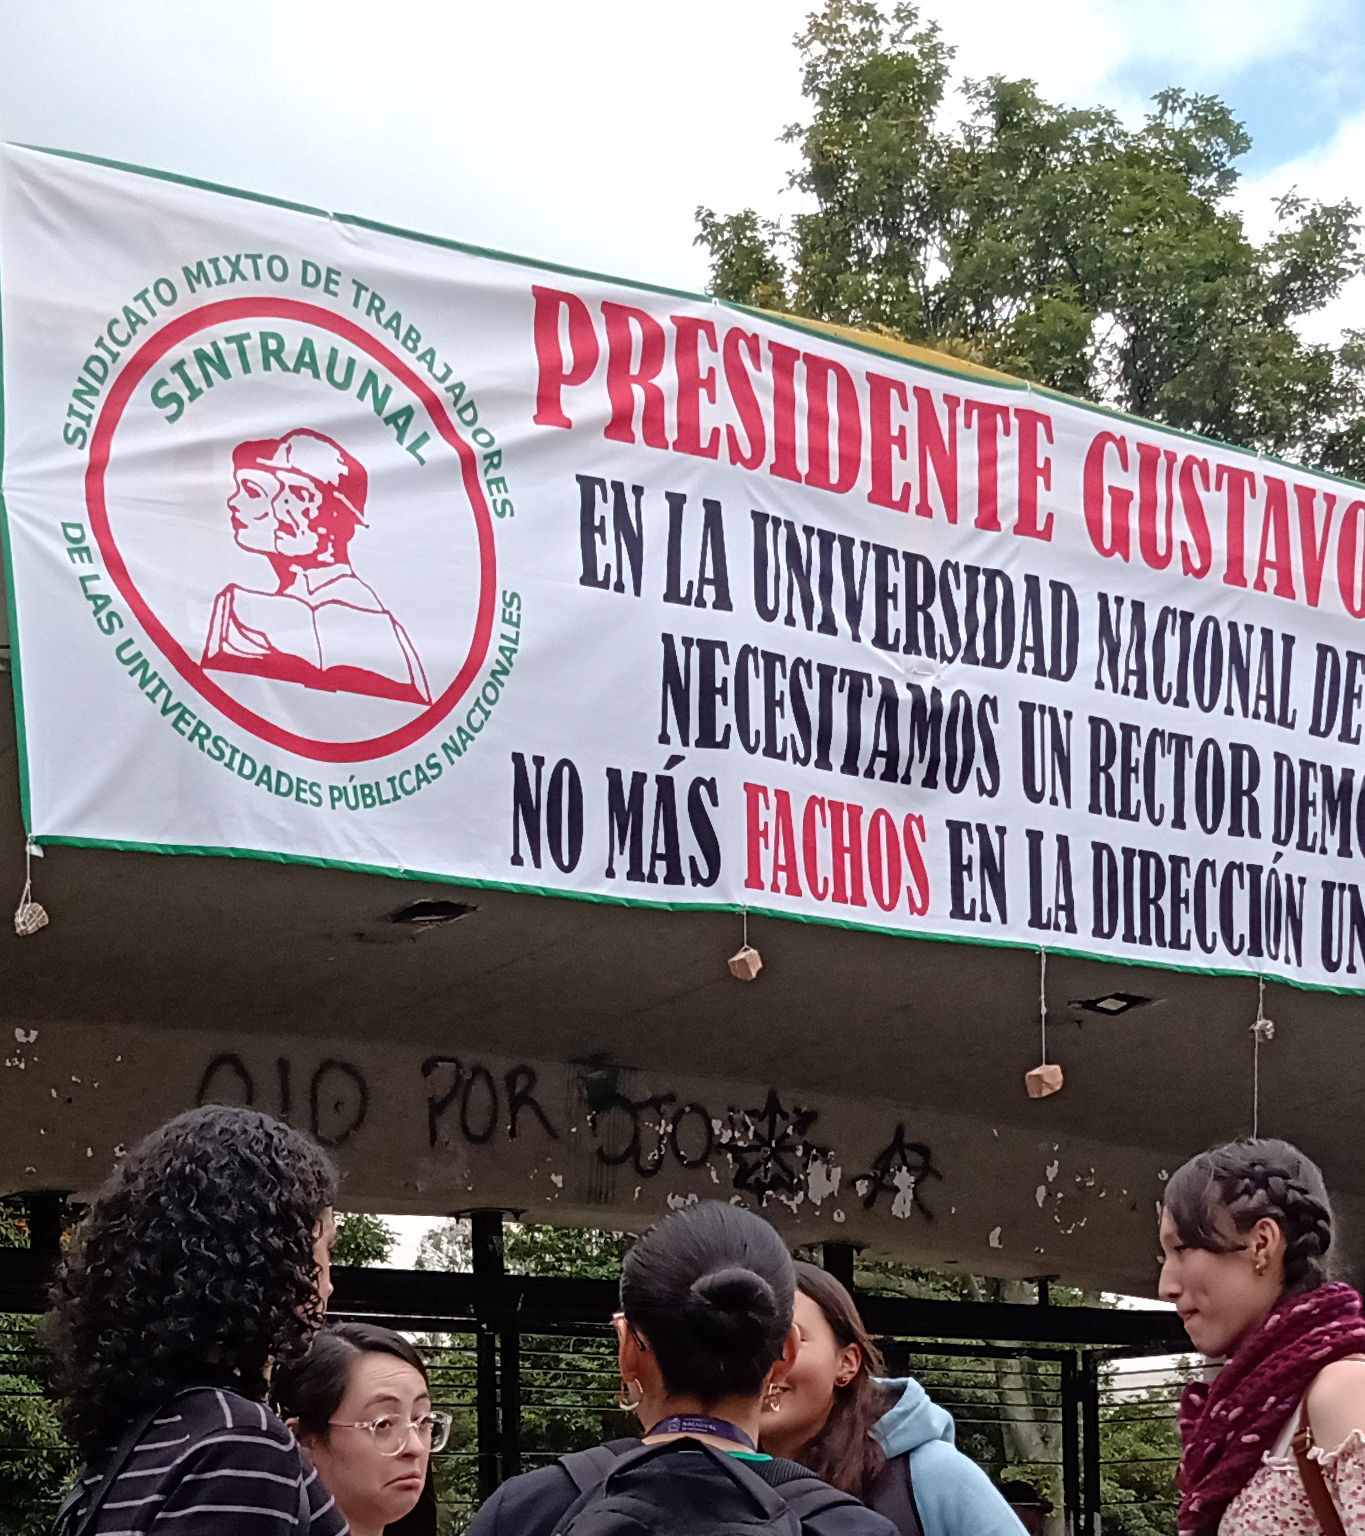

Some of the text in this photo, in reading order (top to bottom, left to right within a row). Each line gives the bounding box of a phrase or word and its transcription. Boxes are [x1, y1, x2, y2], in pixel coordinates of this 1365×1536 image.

[62, 253, 515, 520] SINDICATO MIXTO DE TRABAJADORES
[150, 331, 433, 466] SINTRAUNAL
[531, 284, 1054, 541] PRESIDENTE
[60, 520, 521, 811] DE LAS UNIVERSIDADES PÚBLICAS NACIONALES
[575, 473, 644, 598] EN
[663, 491, 732, 612] LA
[750, 510, 1078, 682] UNIVERSIDAD
[1093, 591, 1297, 731] NACIONAL
[1308, 642, 1365, 746] DE
[657, 632, 999, 799] NECESITAMOS
[1019, 699, 1071, 809] UN
[1087, 715, 1261, 840] RECTOR
[509, 751, 584, 875] NO
[605, 755, 721, 888] MÁS
[742, 780, 930, 917] FACHOS
[946, 818, 1008, 925] EN
[1025, 827, 1077, 935] LA
[1090, 851, 1307, 968] DIRECCIÓN
[419, 1057, 558, 1146] POR
